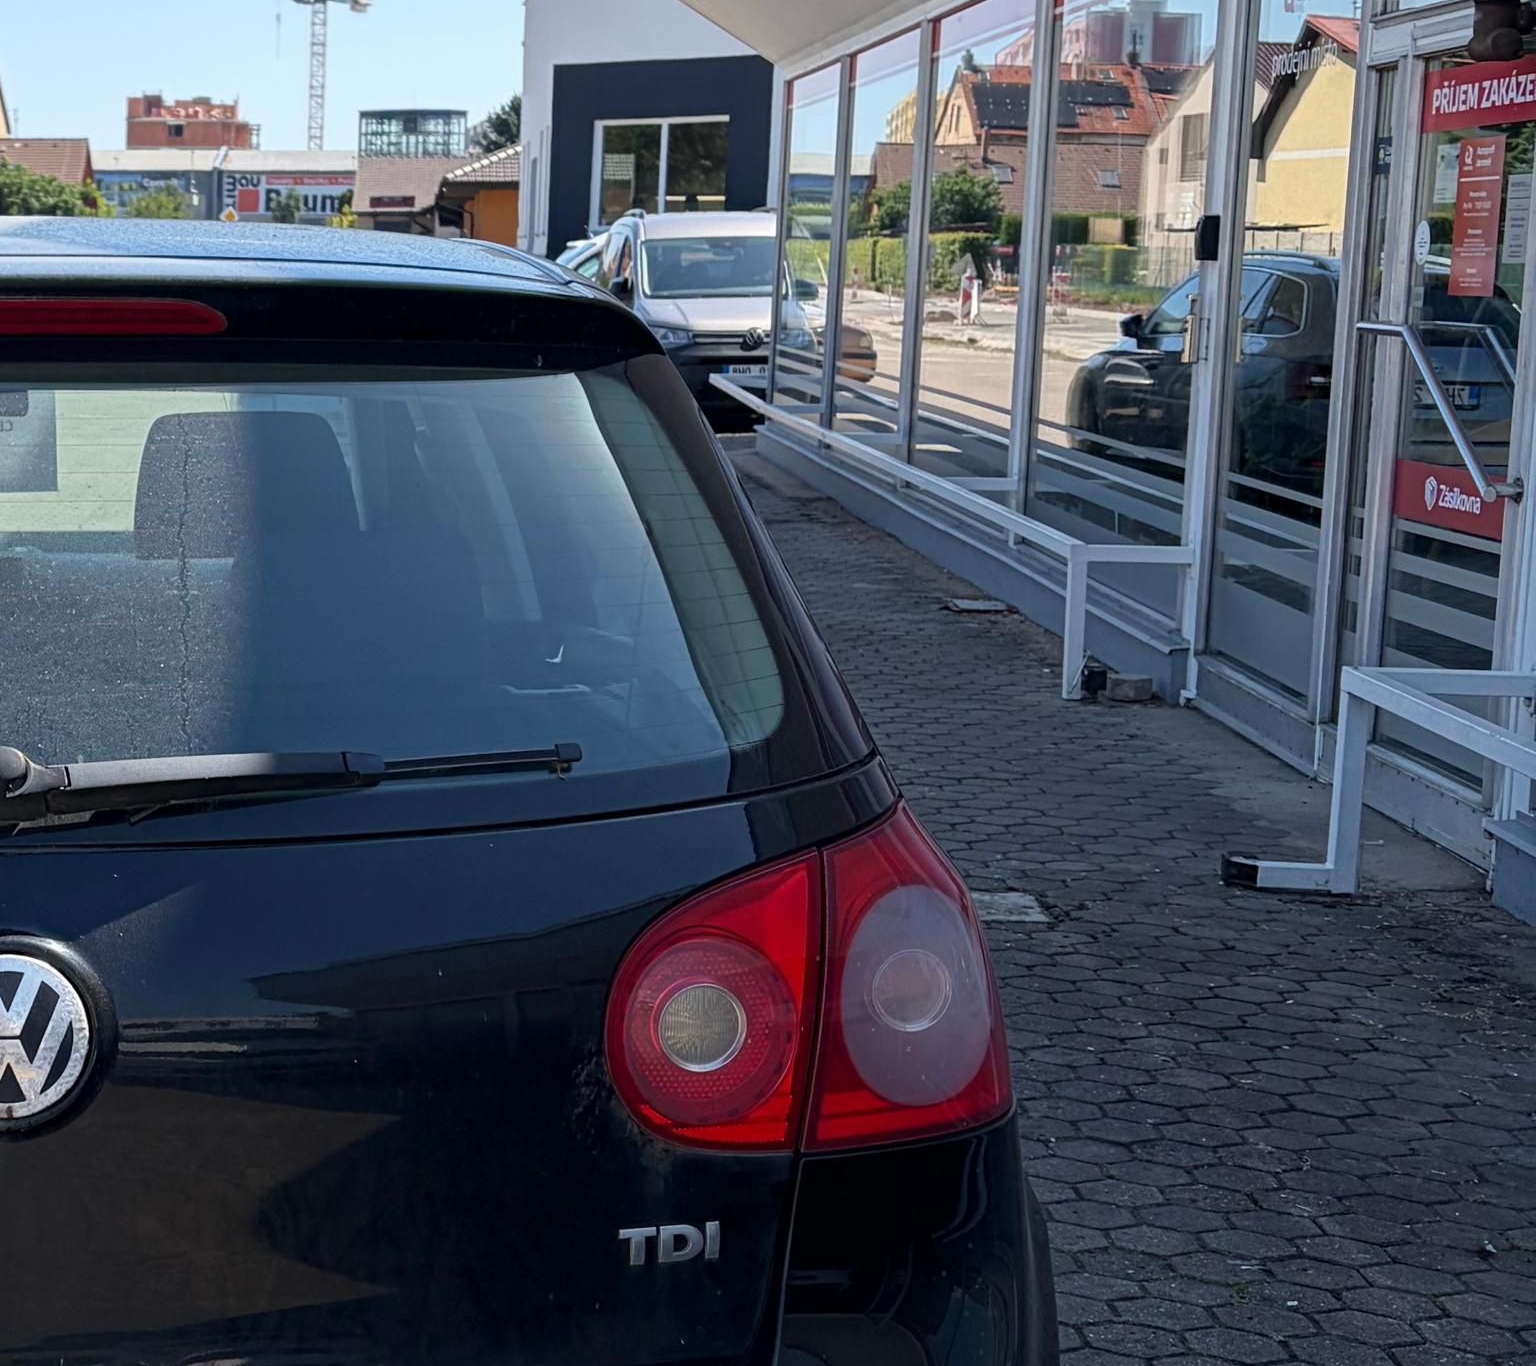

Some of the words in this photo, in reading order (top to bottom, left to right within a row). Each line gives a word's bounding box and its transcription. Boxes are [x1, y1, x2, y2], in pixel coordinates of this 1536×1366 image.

[1270, 41, 1312, 85] prodejní
[1311, 38, 1338, 70] místo
[1431, 80, 1480, 116] PŘÍJEM
[1480, 69, 1536, 109] ZAKÁZE
[1438, 484, 1482, 515] Zásilkovna
[618, 1220, 721, 1266] TDI
